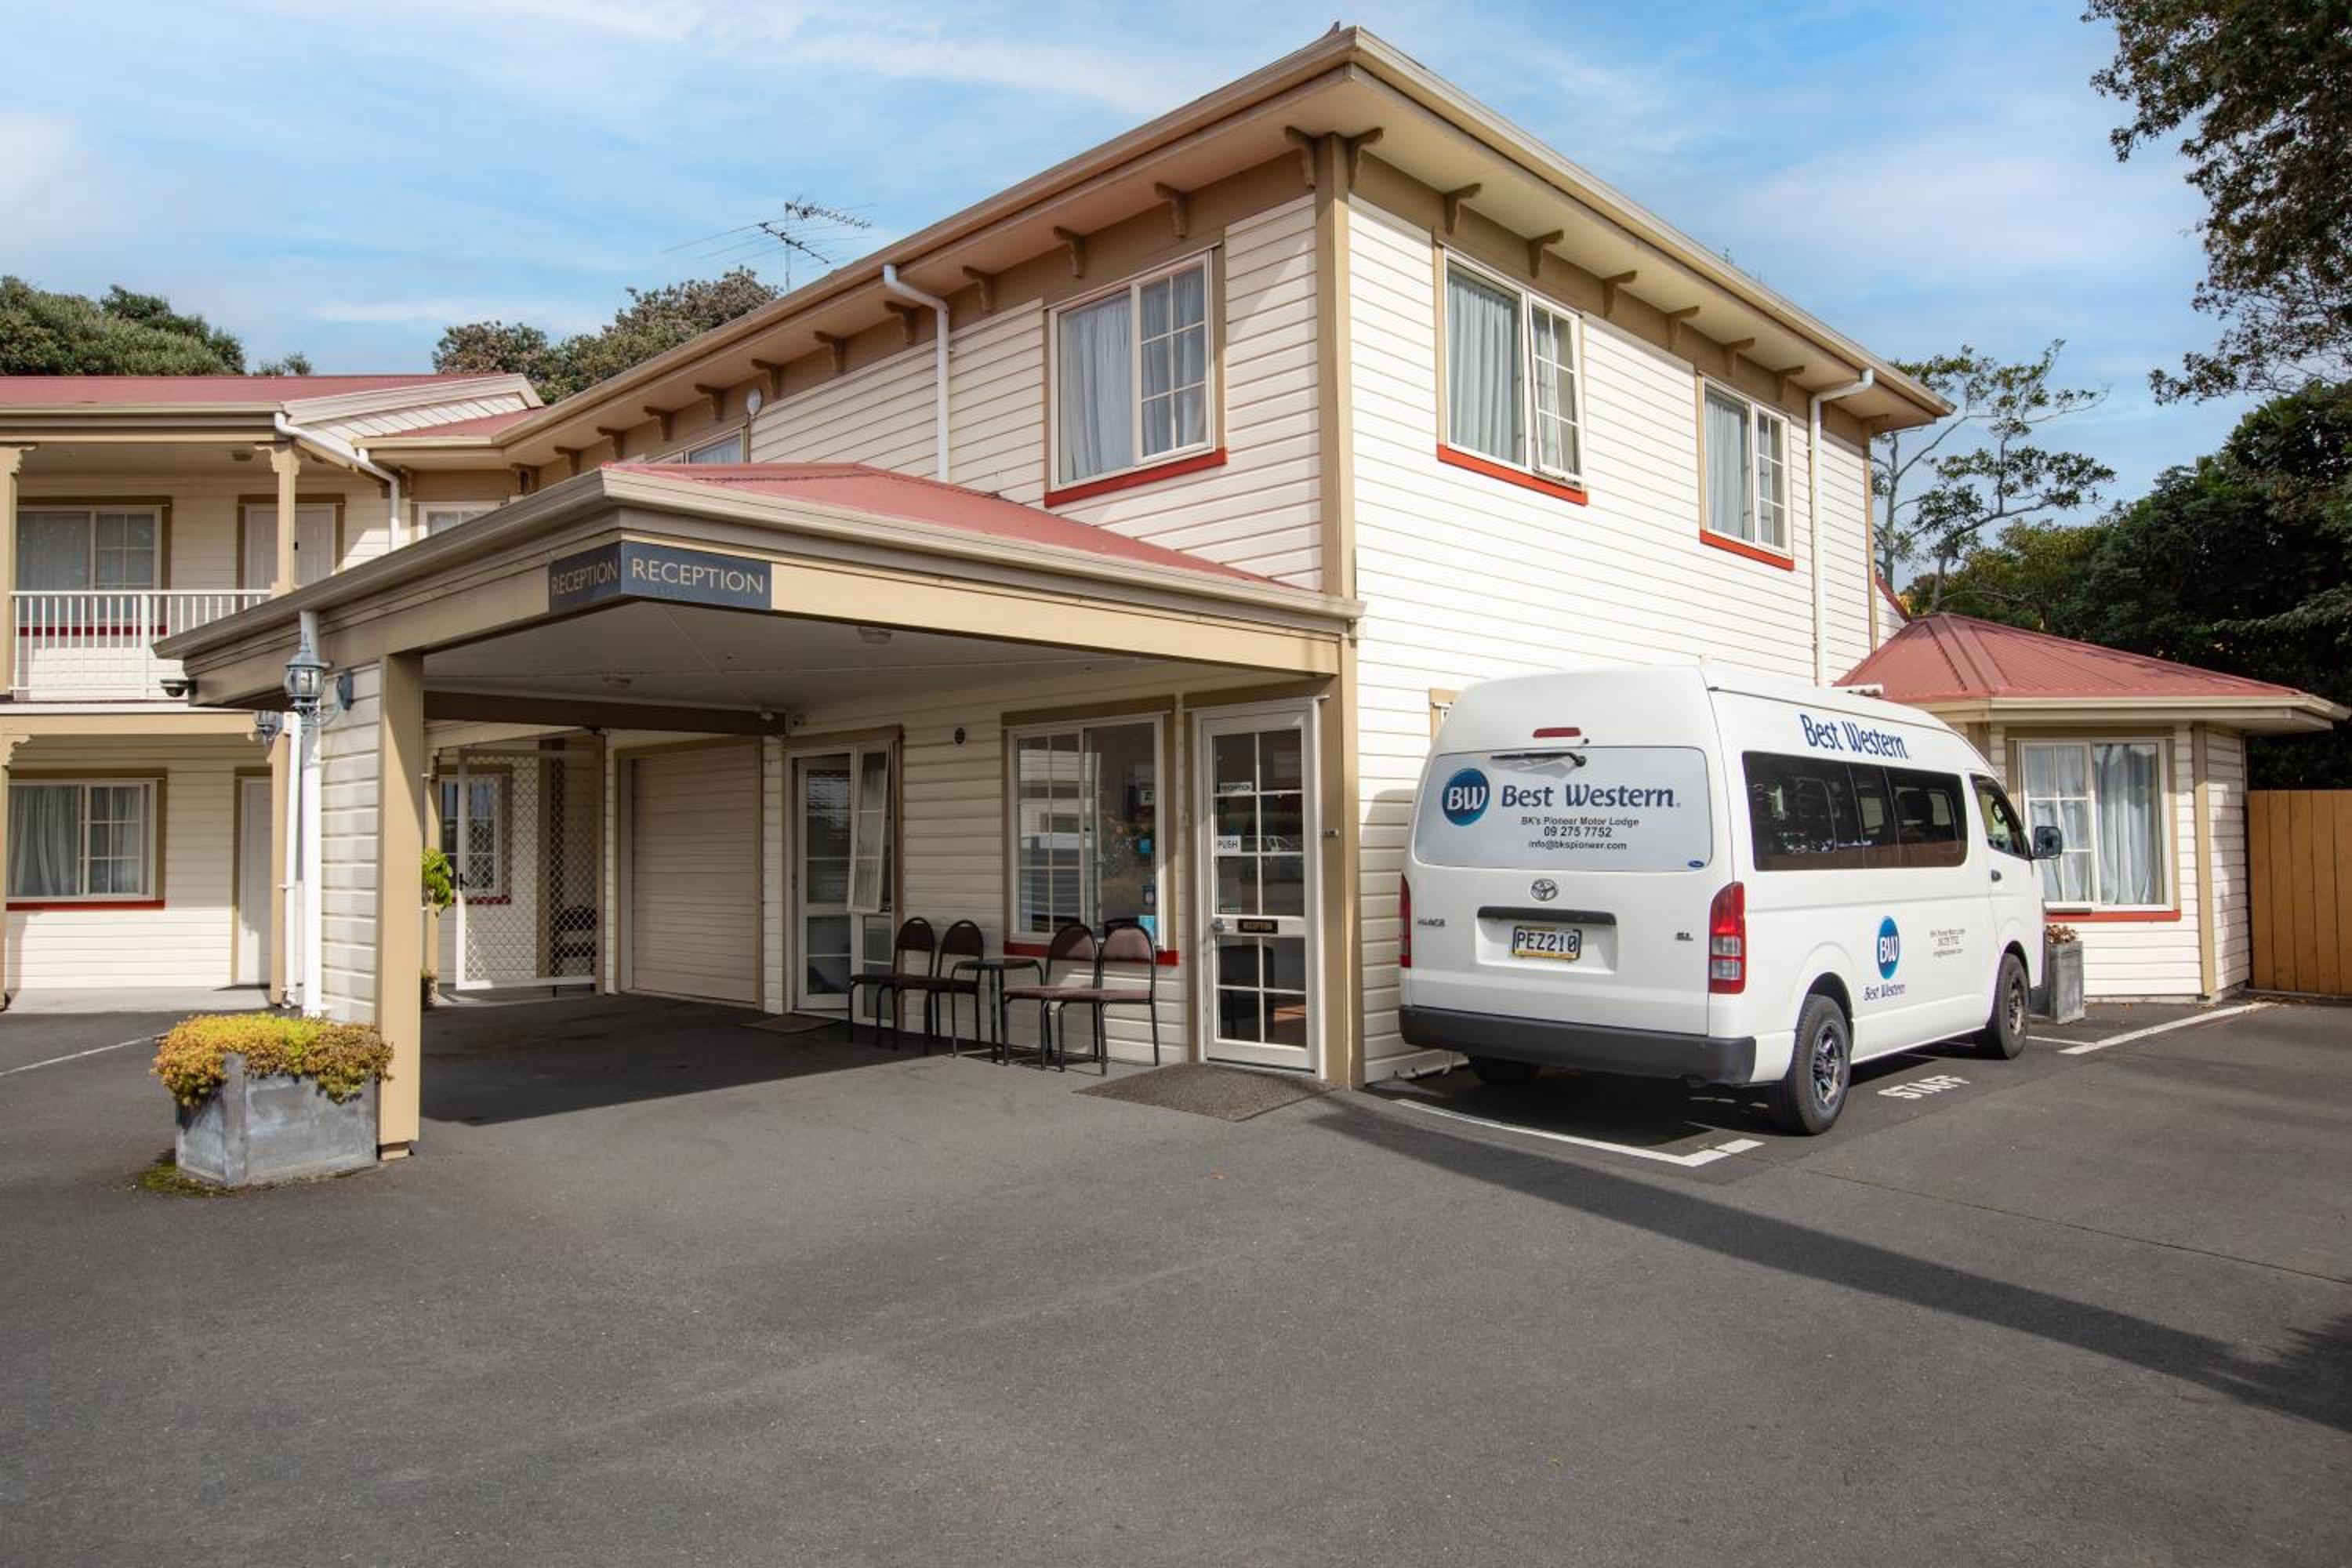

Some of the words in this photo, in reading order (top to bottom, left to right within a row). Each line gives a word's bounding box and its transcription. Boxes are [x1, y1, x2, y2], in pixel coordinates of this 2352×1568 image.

[551, 559, 619, 594] RECEPTION
[632, 557, 764, 593] RECEPTION
[1800, 713, 1844, 750] Best
[1842, 721, 1908, 759] Western
[1447, 786, 1486, 810] BW
[1501, 785, 1554, 808] Best
[1566, 784, 1675, 808] Western
[1521, 816, 1541, 826] BK's
[1544, 816, 1577, 826] Pioneer
[1580, 816, 1606, 826] Motor
[1609, 817, 1639, 828] Lodge
[1544, 826, 1557, 837] 09
[1560, 826, 1581, 837] 275
[1584, 826, 1612, 838] 7752
[1218, 840, 1238, 849] PUSH
[1529, 840, 1627, 851] info@bkspioneer.com
[1516, 931, 1577, 953] PEZ210
[1880, 935, 1897, 963] BW
[1864, 986, 1879, 1000] Best
